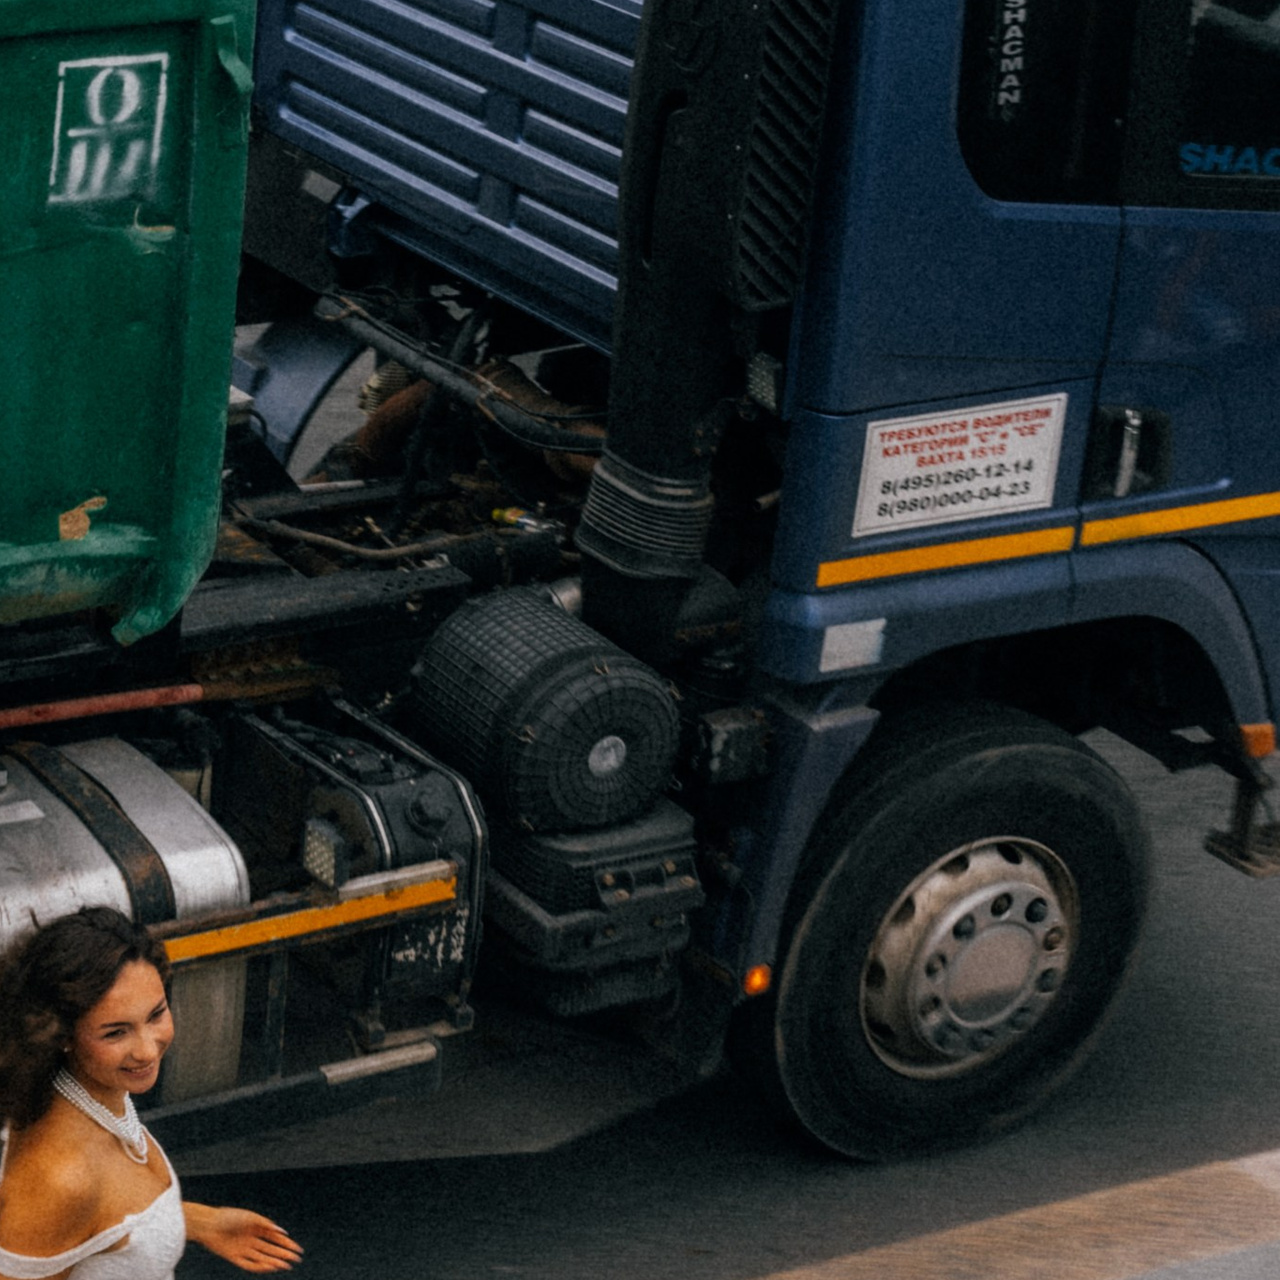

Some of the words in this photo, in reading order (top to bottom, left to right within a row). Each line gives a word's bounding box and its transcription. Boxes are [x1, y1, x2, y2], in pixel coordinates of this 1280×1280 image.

[878, 420, 969, 442] ТРЕБУЮТСЯ
[972, 407, 1053, 429] ВОДИТЕЛИ
[881, 435, 970, 458] КАТЕГОРИИ
[915, 450, 965, 468] ВАХТА
[880, 458, 1034, 496] 8(495)260-12-14
[877, 480, 1031, 518] 8(980)000-04-23
